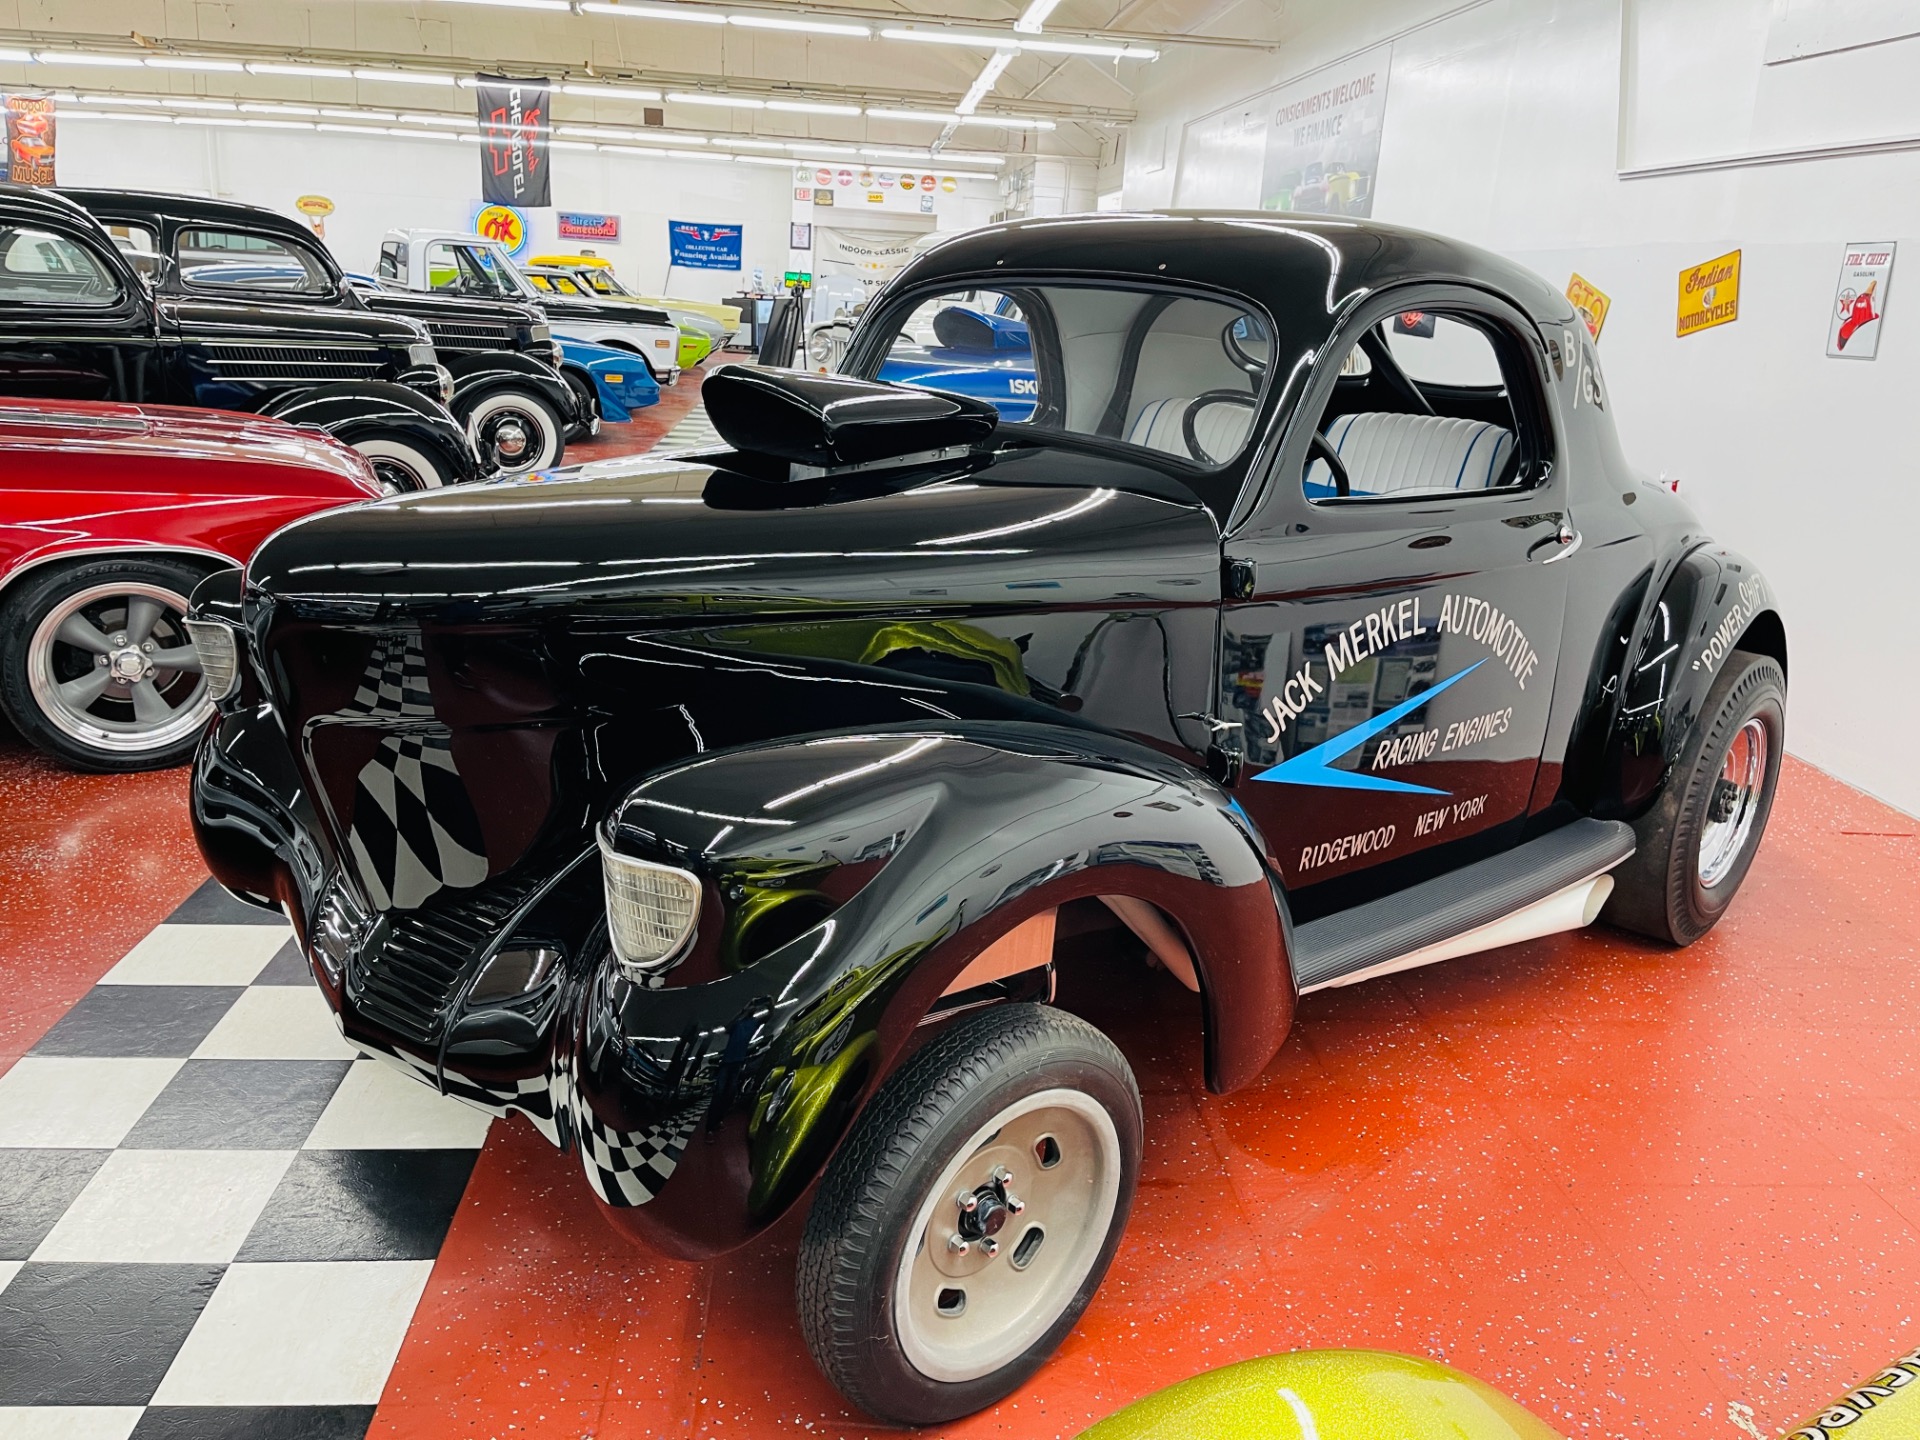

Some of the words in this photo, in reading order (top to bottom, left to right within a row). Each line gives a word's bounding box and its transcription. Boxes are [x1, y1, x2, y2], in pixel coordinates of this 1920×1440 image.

[1276, 90, 1332, 127] CONSIGNMENTS
[1332, 73, 1376, 107] WELCOME
[1293, 126, 1306, 147] WE
[1306, 114, 1343, 144] FINANCE
[484, 214, 517, 242] OK
[561, 225, 609, 236] connection
[571, 215, 597, 226] direct
[674, 249, 707, 261] Financing
[709, 253, 739, 261] Available
[685, 244, 715, 252] COLLECTOR
[839, 243, 872, 256] INDOOR
[874, 247, 909, 256] CLASSIC
[1845, 254, 1865, 266] FIRE
[1866, 253, 1890, 266] CHIEF
[1686, 264, 1734, 294] Indian
[1567, 280, 1604, 325] GTO
[1679, 300, 1736, 331] MOTORCYCLES
[1009, 379, 1039, 395] ISK
[1260, 661, 1323, 744] JACK
[1324, 596, 1427, 682] MERKEL
[1436, 594, 1539, 691] AUTOMOTIVE
[1372, 728, 1440, 771] RACING
[1442, 707, 1513, 752] ENGINES
[1299, 824, 1396, 872] RIDGEWOOD
[1413, 806, 1450, 838] NEW
[1452, 794, 1488, 824] YORK
